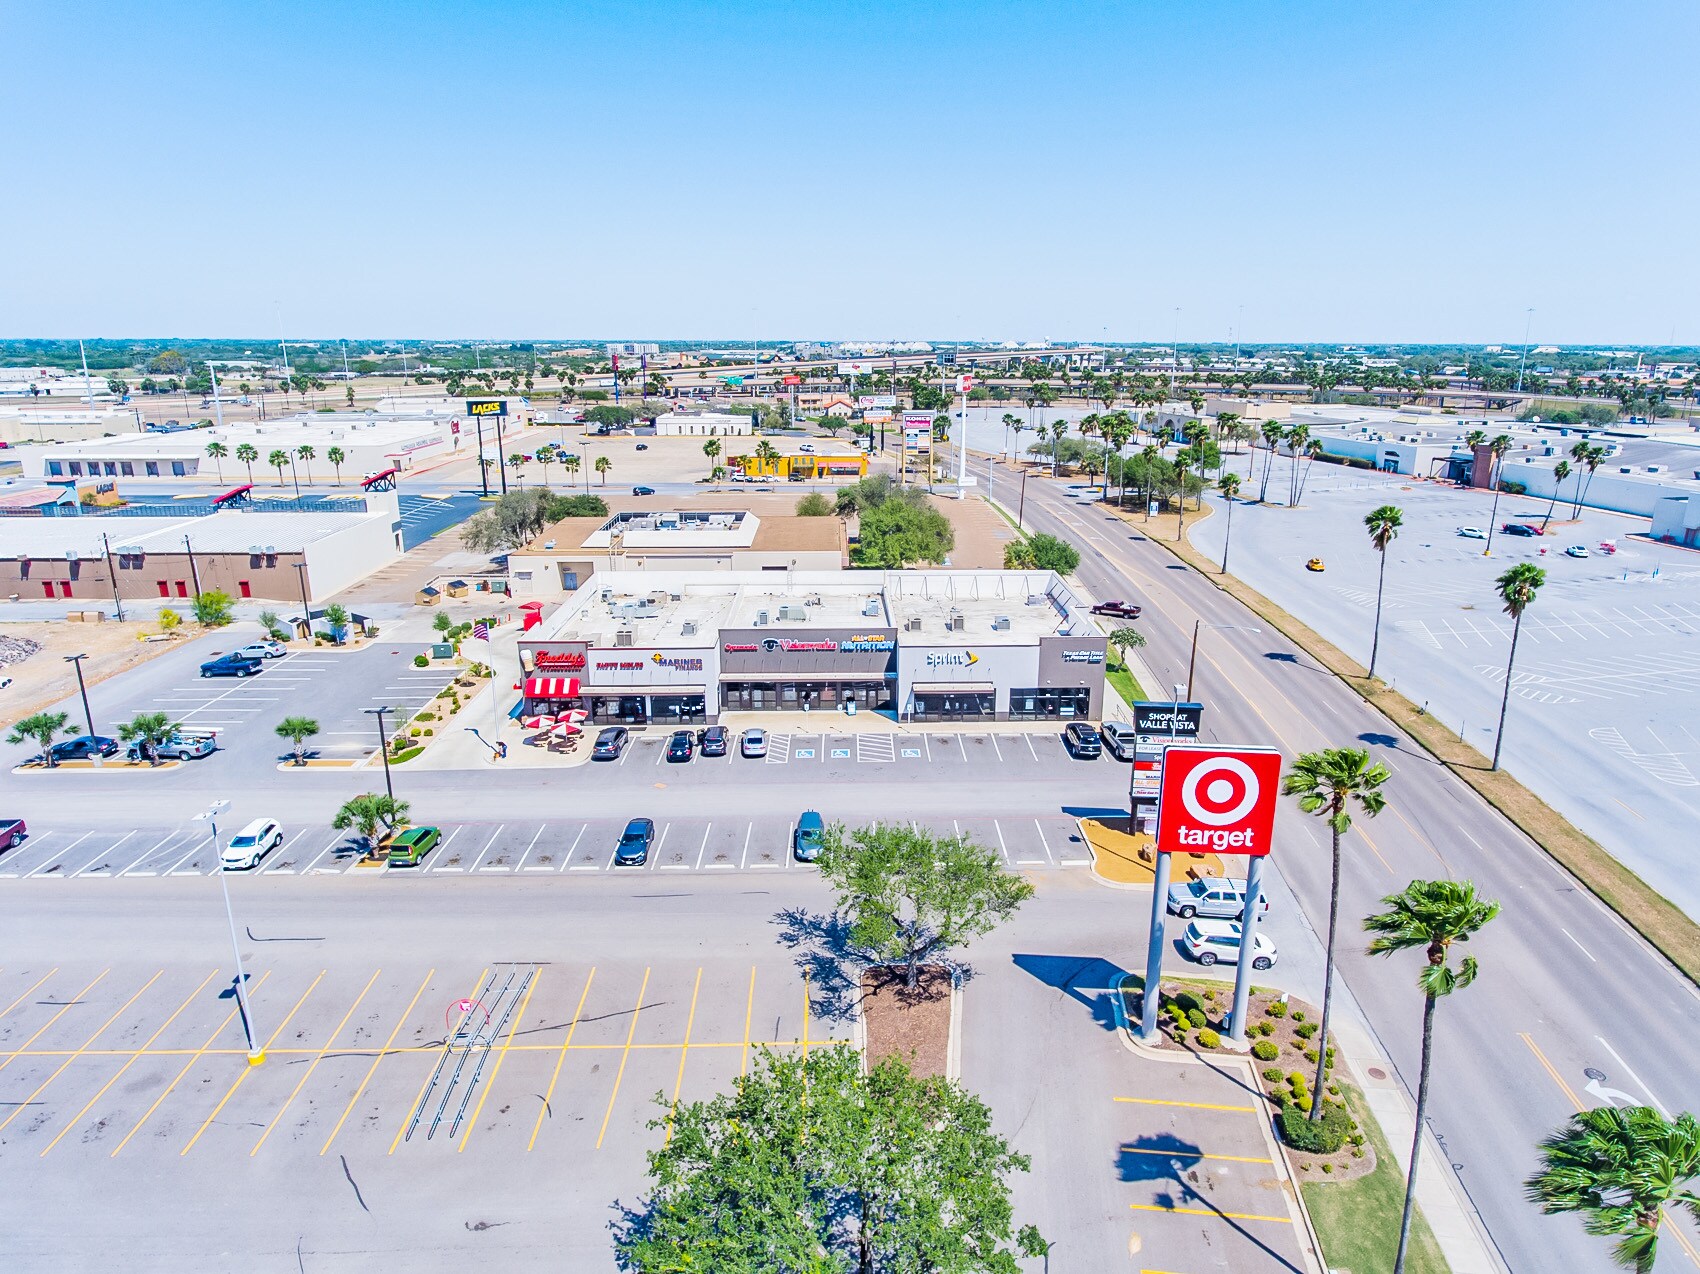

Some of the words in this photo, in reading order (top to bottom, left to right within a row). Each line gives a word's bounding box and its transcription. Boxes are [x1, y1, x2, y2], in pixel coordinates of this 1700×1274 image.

[472, 402, 500, 415] LACKS
[779, 638, 838, 650] Visionworks
[536, 650, 586, 666] Freddy's
[660, 658, 702, 666] MARINER
[927, 650, 964, 667] Sprint
[1148, 712, 1175, 721] SHOPS
[1176, 713, 1188, 721] AT
[1139, 719, 1168, 729] VALLE
[1169, 721, 1196, 730] VISTA
[1178, 825, 1254, 851] target
